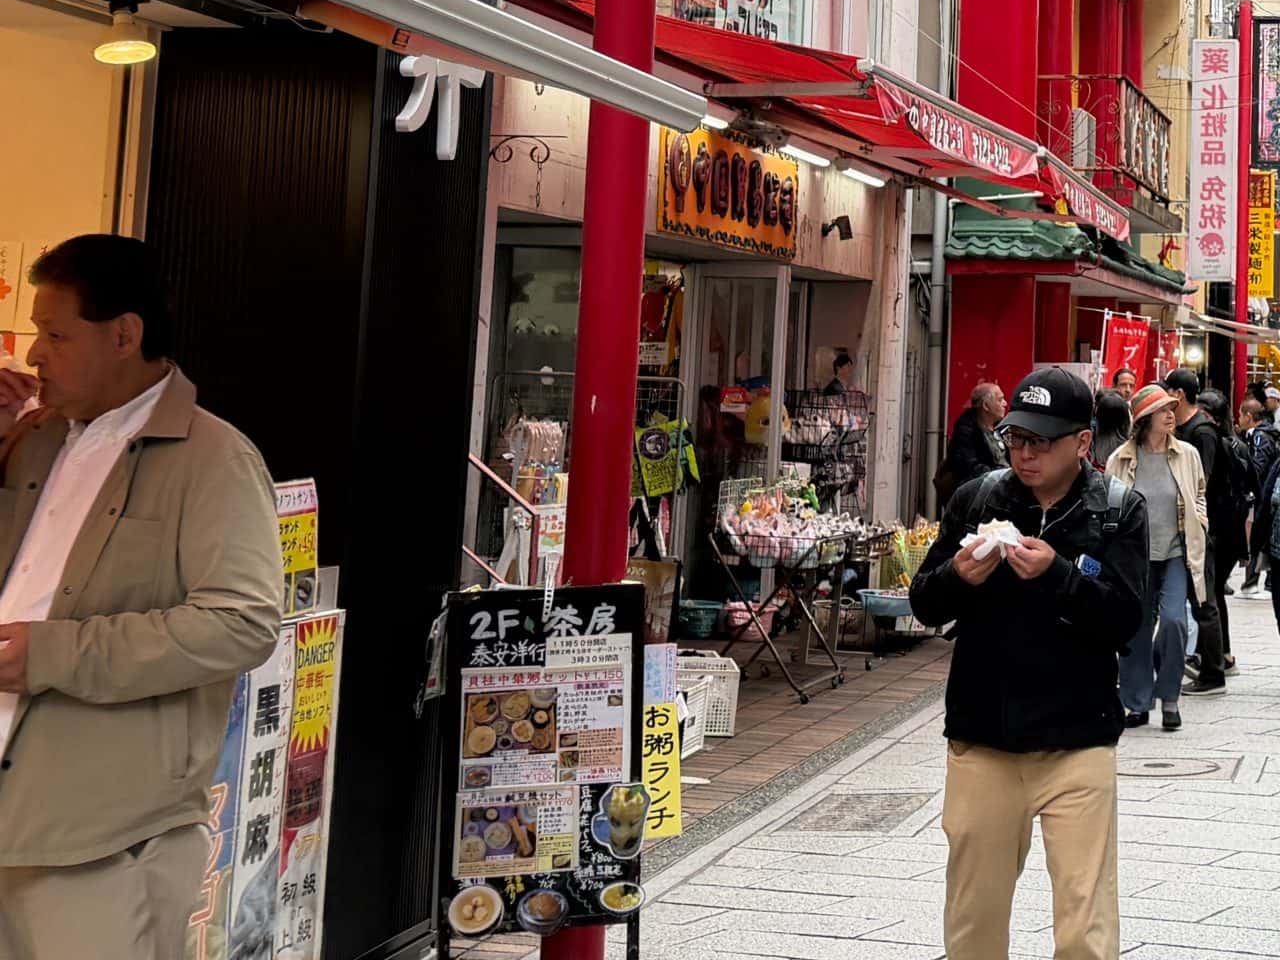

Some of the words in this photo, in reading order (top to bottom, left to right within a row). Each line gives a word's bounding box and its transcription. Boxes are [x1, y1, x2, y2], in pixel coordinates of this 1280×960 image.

[297, 641, 336, 670] DANGER
[469, 608, 521, 640] 2F
[240, 683, 281, 868] 黒胡麻
[643, 705, 675, 831] お粥ランチ
